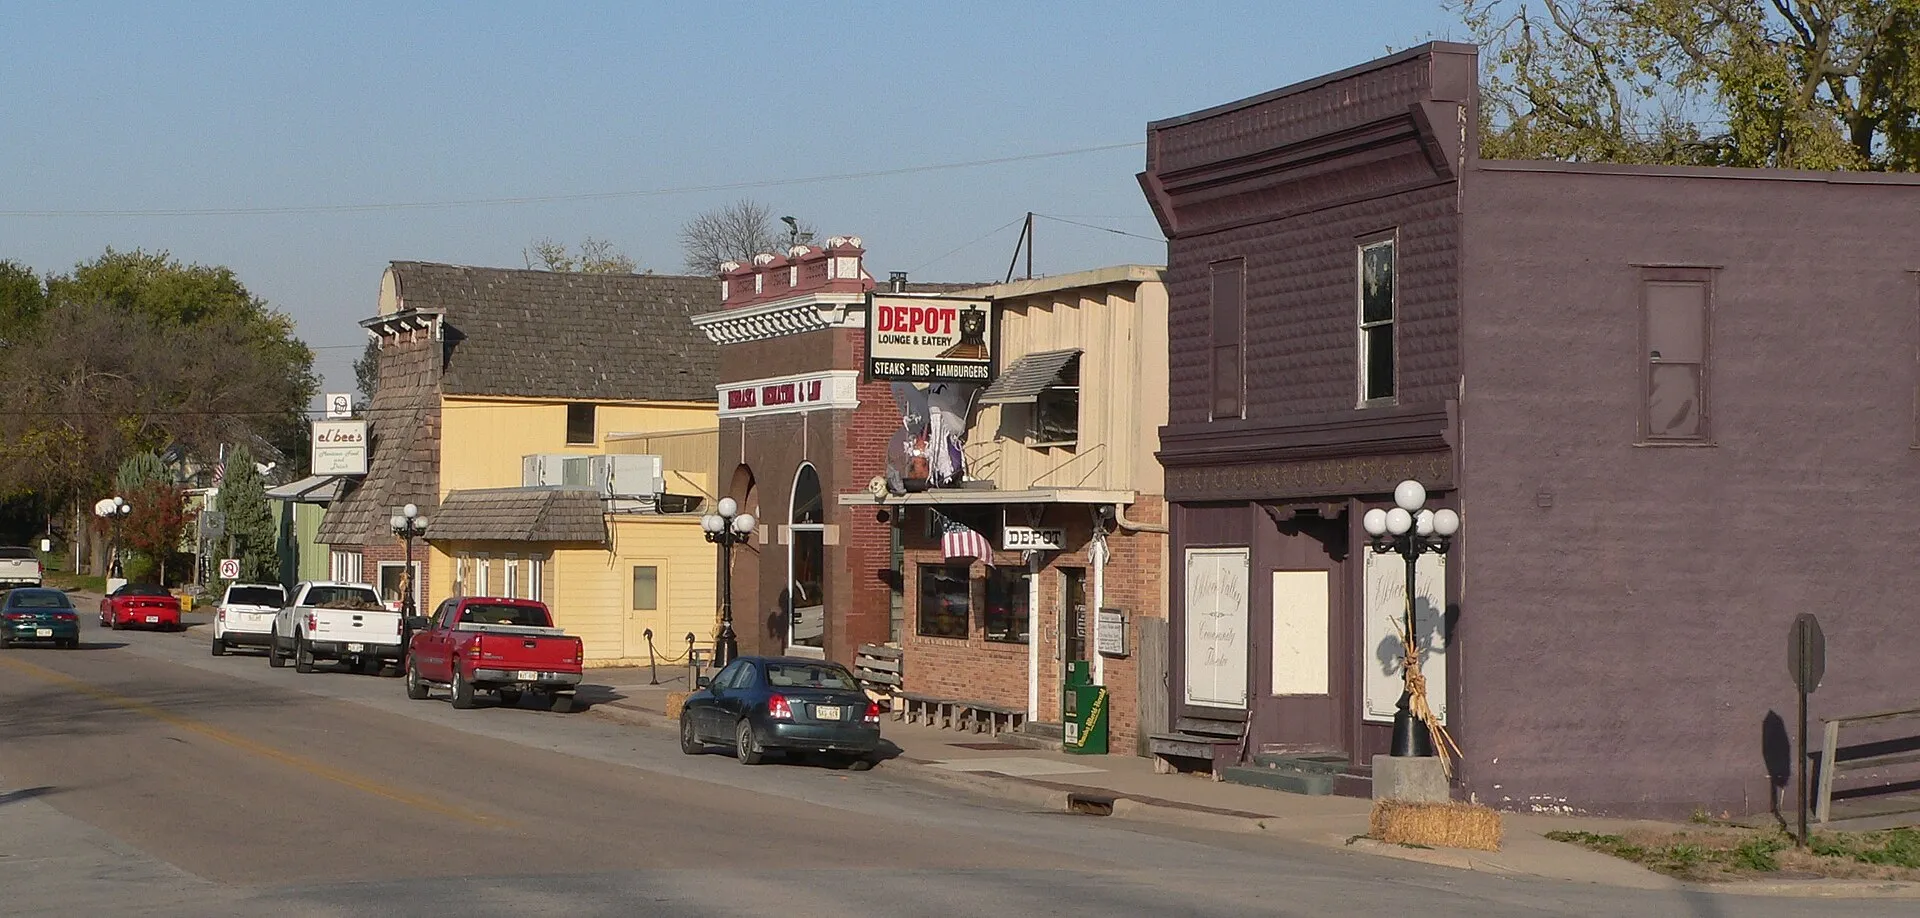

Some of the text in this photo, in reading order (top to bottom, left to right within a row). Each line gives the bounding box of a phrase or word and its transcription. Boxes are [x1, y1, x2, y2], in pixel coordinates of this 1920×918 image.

[878, 306, 956, 334] DEPOT
[878, 334, 952, 346] LOUNGE & EATERY
[874, 362, 989, 378] STEAKS RIBS HAMBURGERS
[798, 382, 805, 402] &
[1009, 530, 1061, 545] DEPOT
